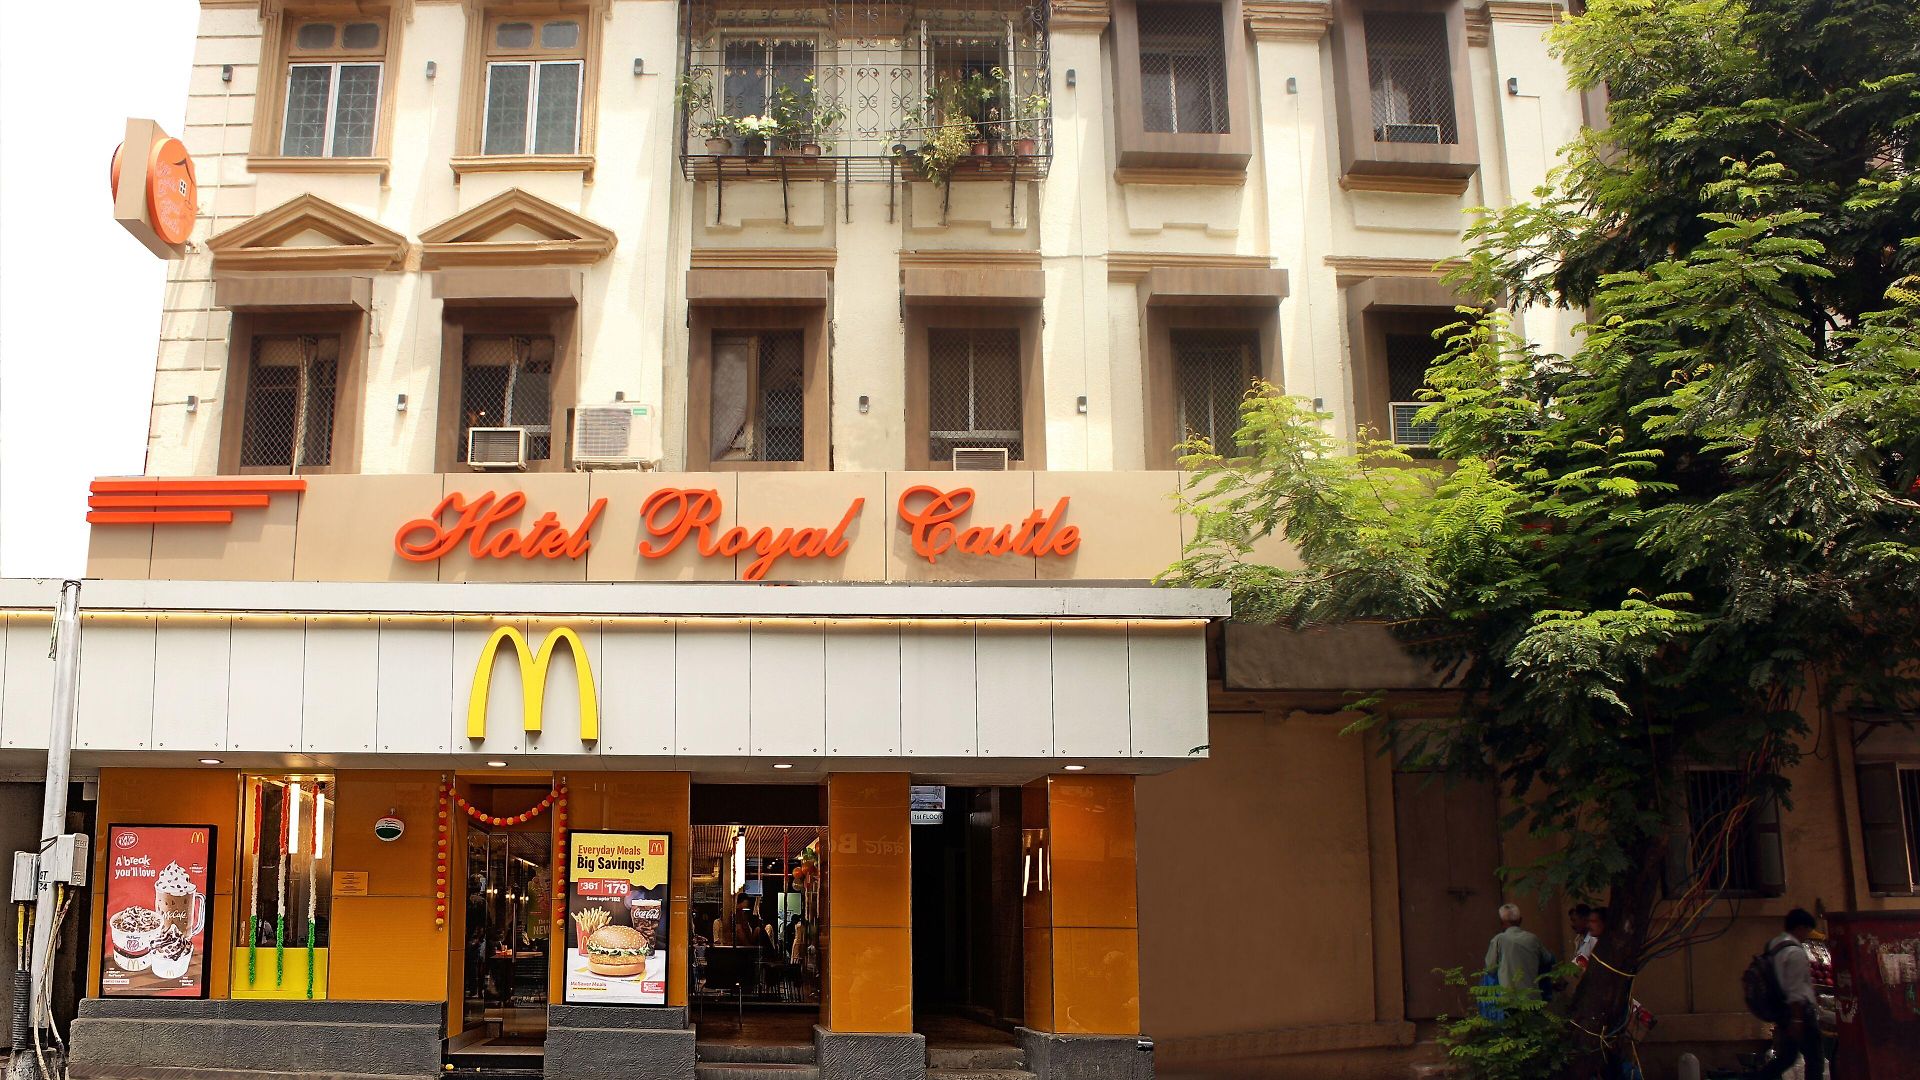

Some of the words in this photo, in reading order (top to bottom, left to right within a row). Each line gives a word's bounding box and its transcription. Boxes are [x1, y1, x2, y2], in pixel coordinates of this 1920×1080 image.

[394, 490, 608, 561] Hotel
[638, 487, 865, 581] Royal
[898, 485, 1082, 564] Castle
[578, 845, 615, 857] Everyday
[617, 845, 641, 856] Meals
[115, 856, 122, 867] A
[124, 854, 151, 867] break
[577, 857, 595, 873] Big
[598, 856, 645, 874] Savings!
[114, 867, 138, 880] you'll
[139, 867, 156, 878] love
